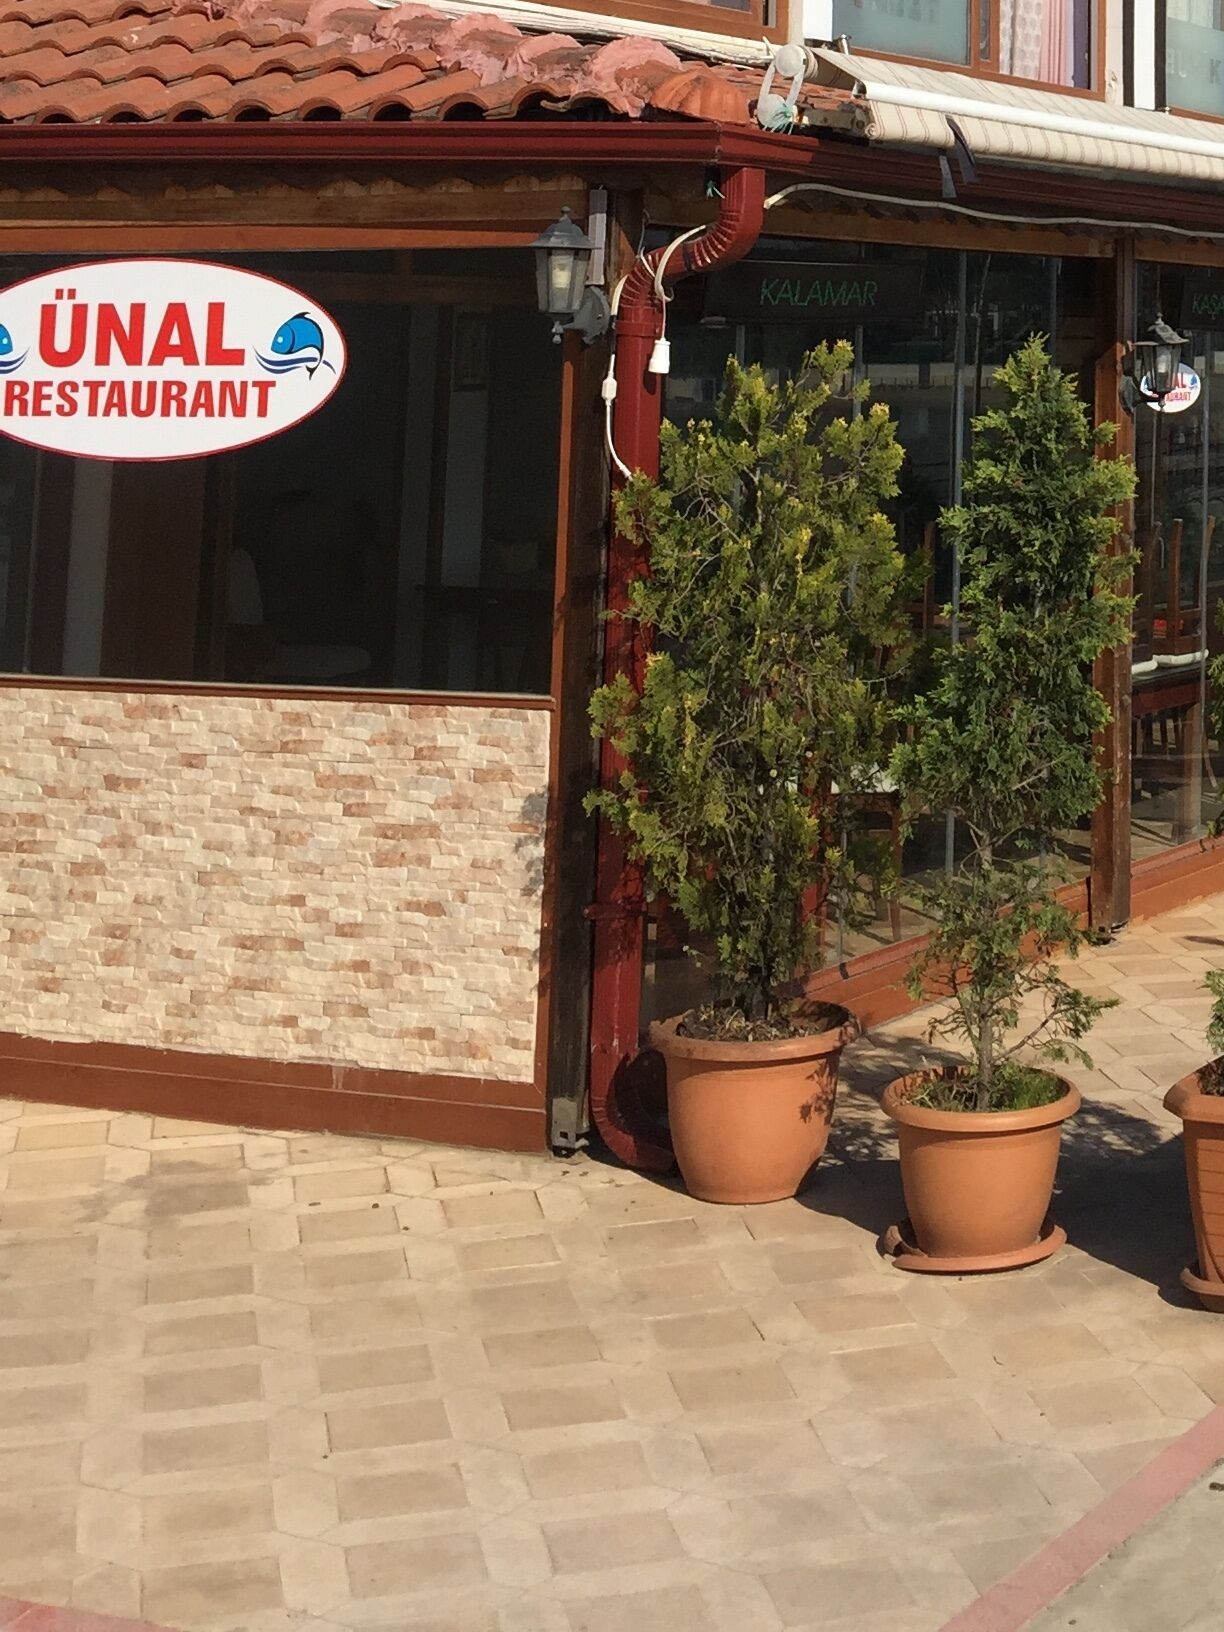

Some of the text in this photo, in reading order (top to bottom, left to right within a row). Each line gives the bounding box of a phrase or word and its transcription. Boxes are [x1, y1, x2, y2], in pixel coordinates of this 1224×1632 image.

[760, 278, 879, 306] KALAMAR
[39, 288, 246, 367] ÜNAL
[3, 380, 276, 419] RESTAURANT
